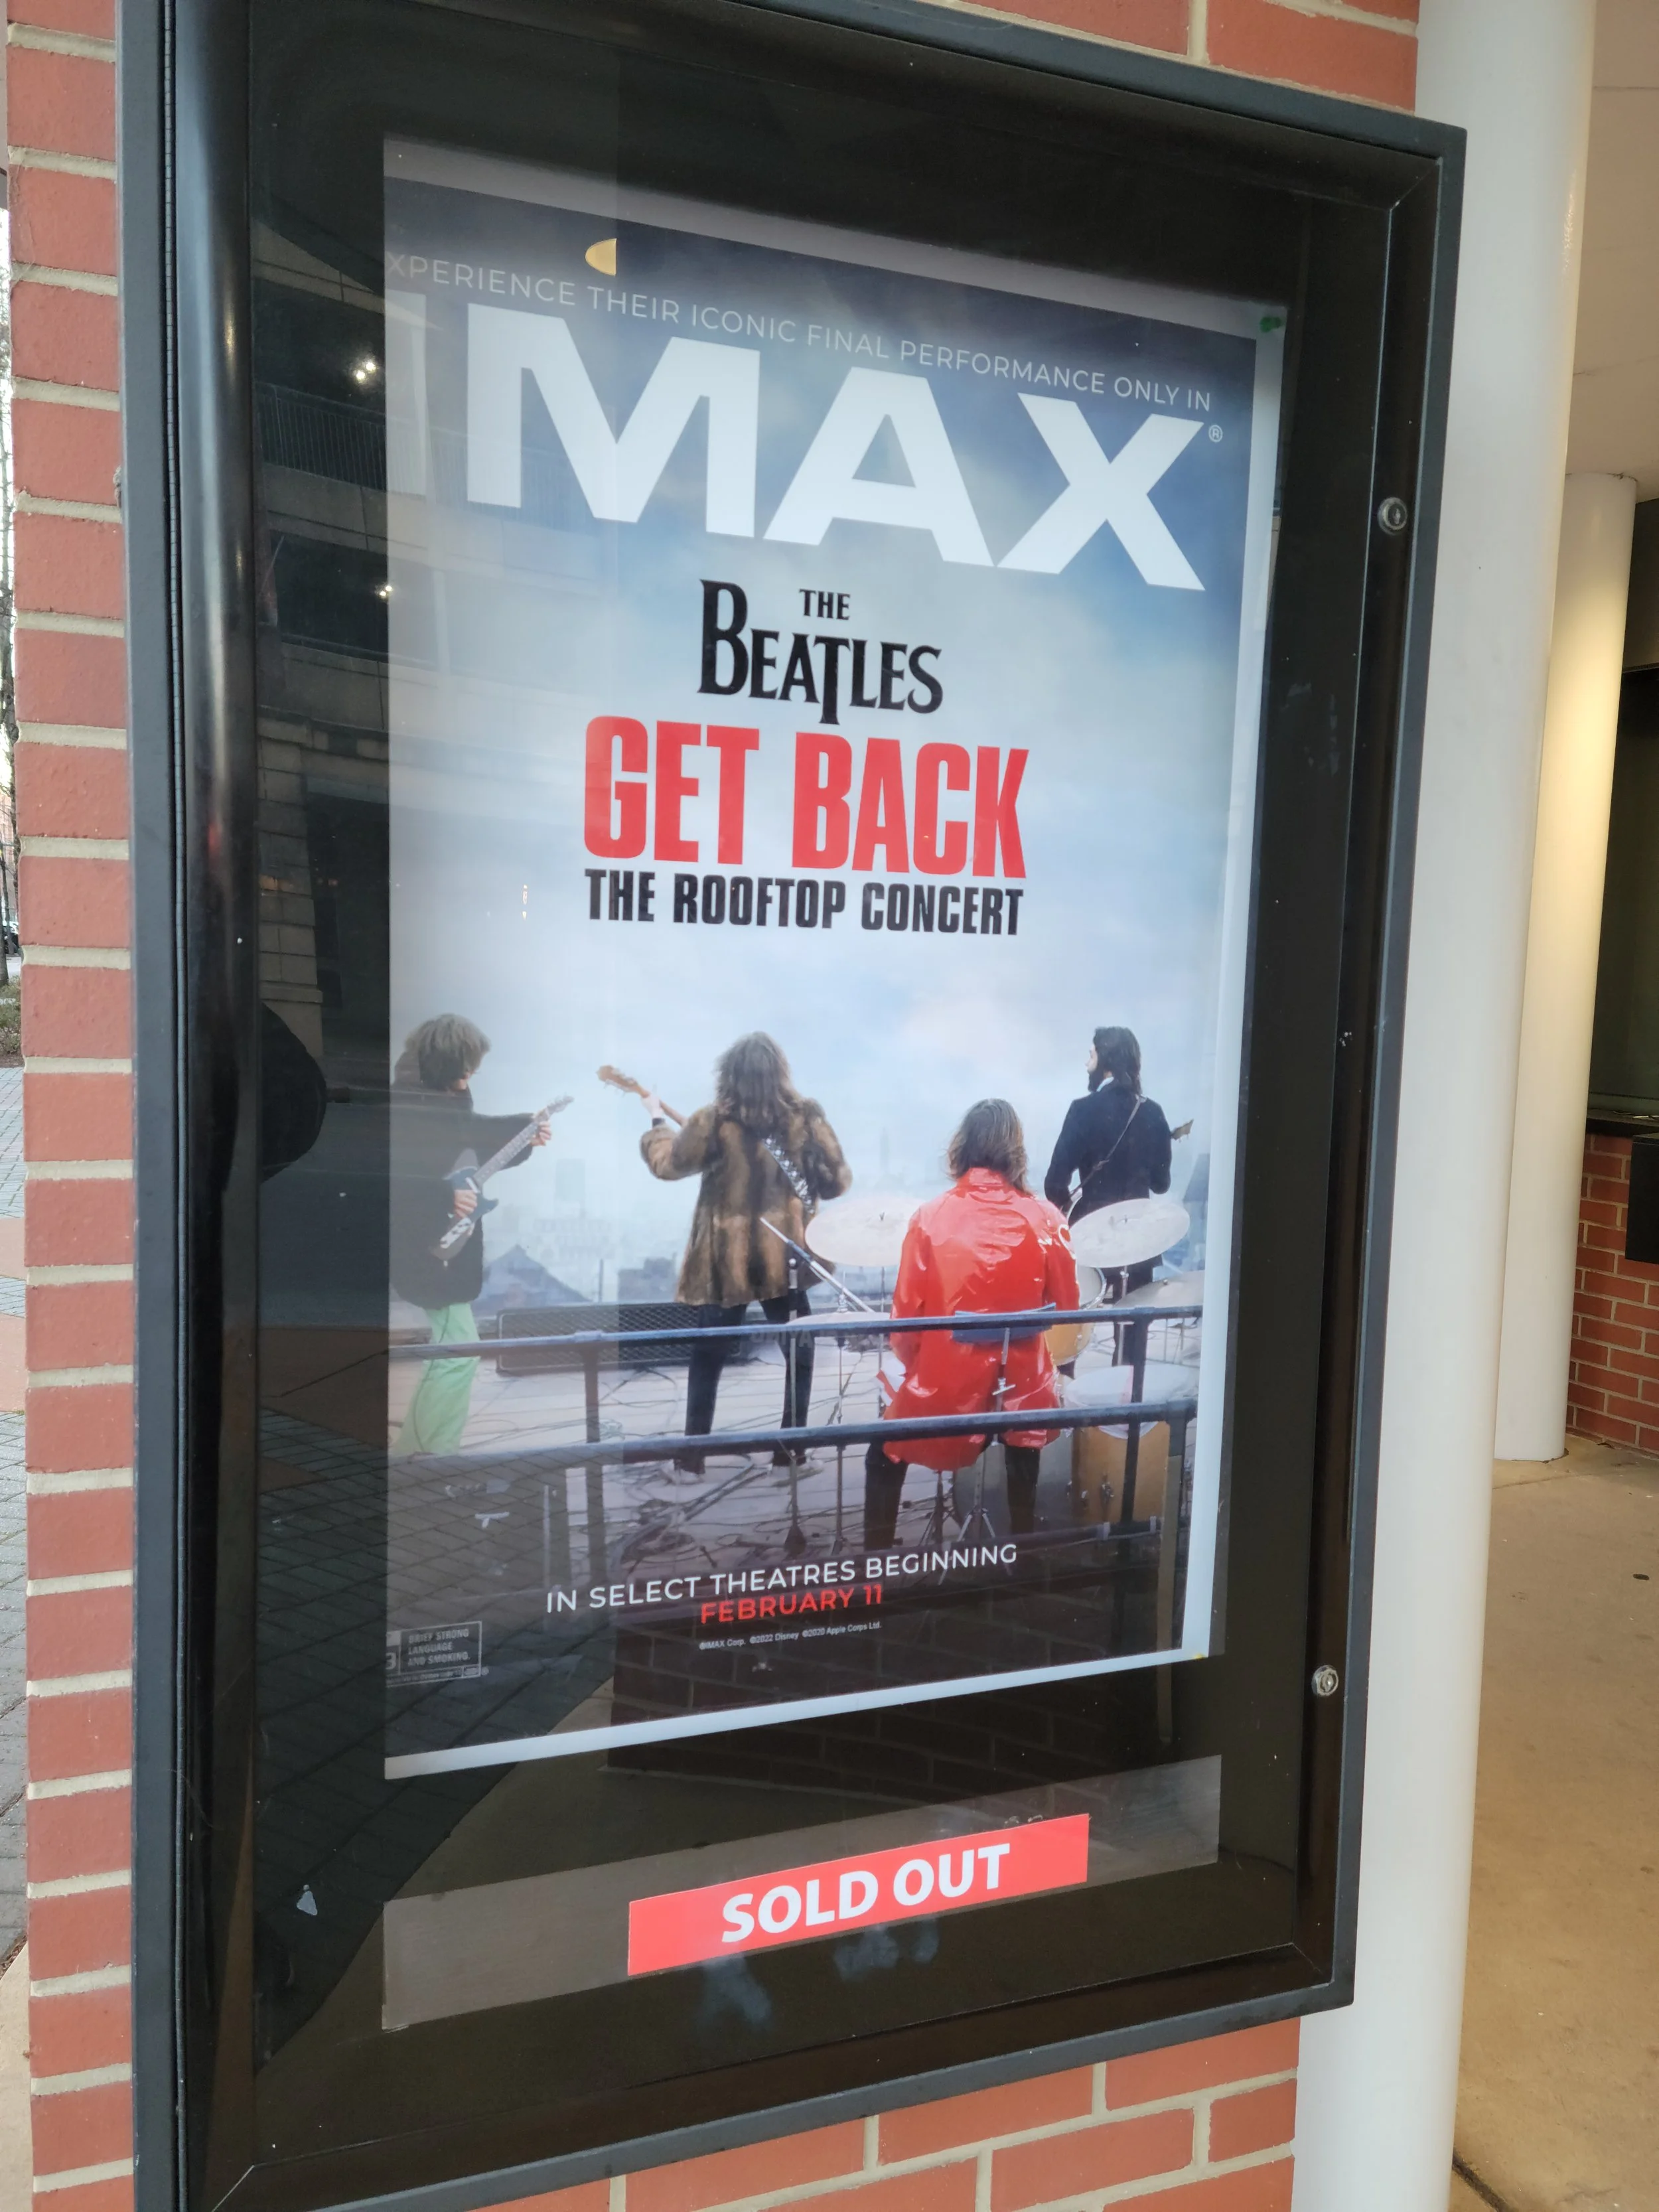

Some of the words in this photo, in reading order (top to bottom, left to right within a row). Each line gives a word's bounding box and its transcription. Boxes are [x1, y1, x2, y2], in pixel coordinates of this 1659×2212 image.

[587, 286, 680, 325] THEIR
[691, 304, 796, 343] ICONIC
[808, 325, 889, 358] FINAL
[901, 340, 1106, 394] PERFORMANCE
[1114, 376, 1180, 406] ONLY
[1188, 389, 1210, 412] IN
[798, 589, 851, 621] THE
[697, 579, 944, 725] BEATLES
[584, 715, 760, 865] GET
[791, 731, 1030, 879] BACK
[585, 868, 656, 922] THE
[673, 873, 845, 929] ROOFTOP
[861, 882, 1024, 936] CONCERT
[547, 1591, 577, 1613] IN
[589, 1576, 702, 1609] SELECT
[710, 1560, 856, 1595] THEATRES
[865, 1544, 1017, 1578] BEGINNING
[700, 1591, 853, 1625] FEBRUARY
[864, 1585, 883, 1605] 11
[408, 1641, 453, 1655] LANGUAGE
[435, 1629, 469, 1641] STRONG
[727, 1639, 746, 1648] Corp.
[775, 1631, 799, 1642] Disney
[826, 1627, 846, 1635] Apple
[847, 1623, 867, 1633] Corps
[869, 1621, 882, 1630] Ltd.
[721, 1870, 879, 1943] SOLD
[893, 1843, 1010, 1905] OUT
